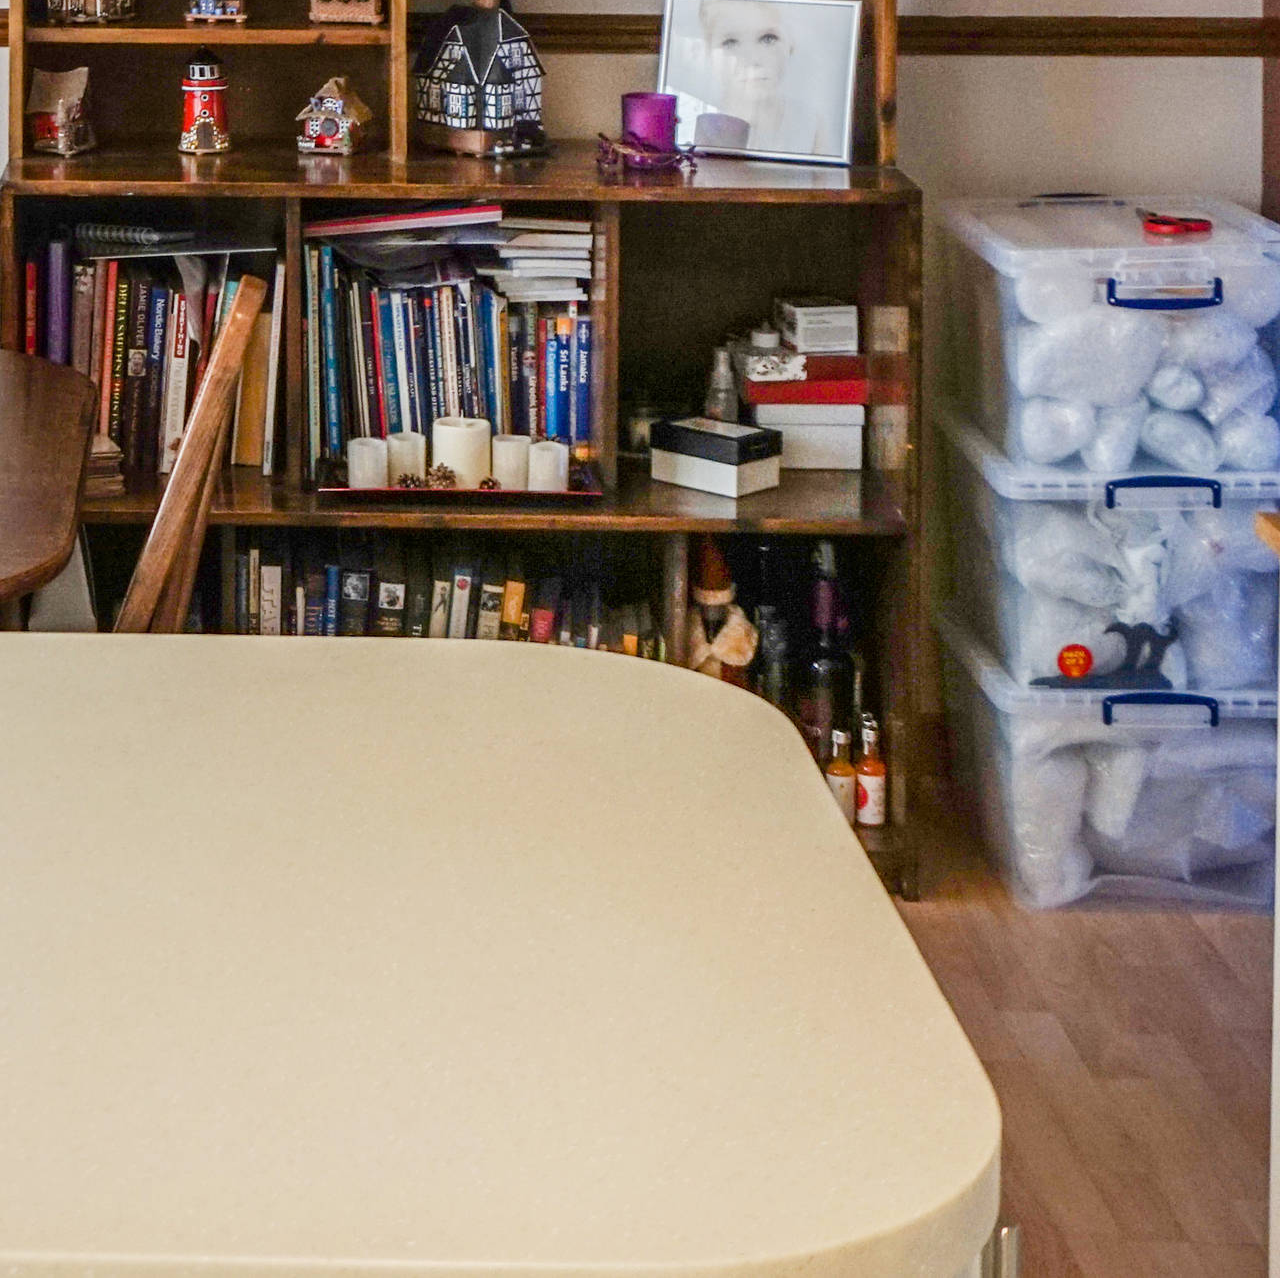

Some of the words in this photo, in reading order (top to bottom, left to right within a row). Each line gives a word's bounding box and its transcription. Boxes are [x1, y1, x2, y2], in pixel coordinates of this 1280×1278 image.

[138, 283, 147, 311] JAMIE
[154, 298, 165, 327] Nordic
[135, 313, 146, 347] OLIVER
[151, 328, 163, 361] Bakery
[559, 349, 569, 362] Sri
[559, 364, 569, 392] Lanka
[579, 349, 589, 383] Jamaica
[327, 598, 337, 619] HOT
